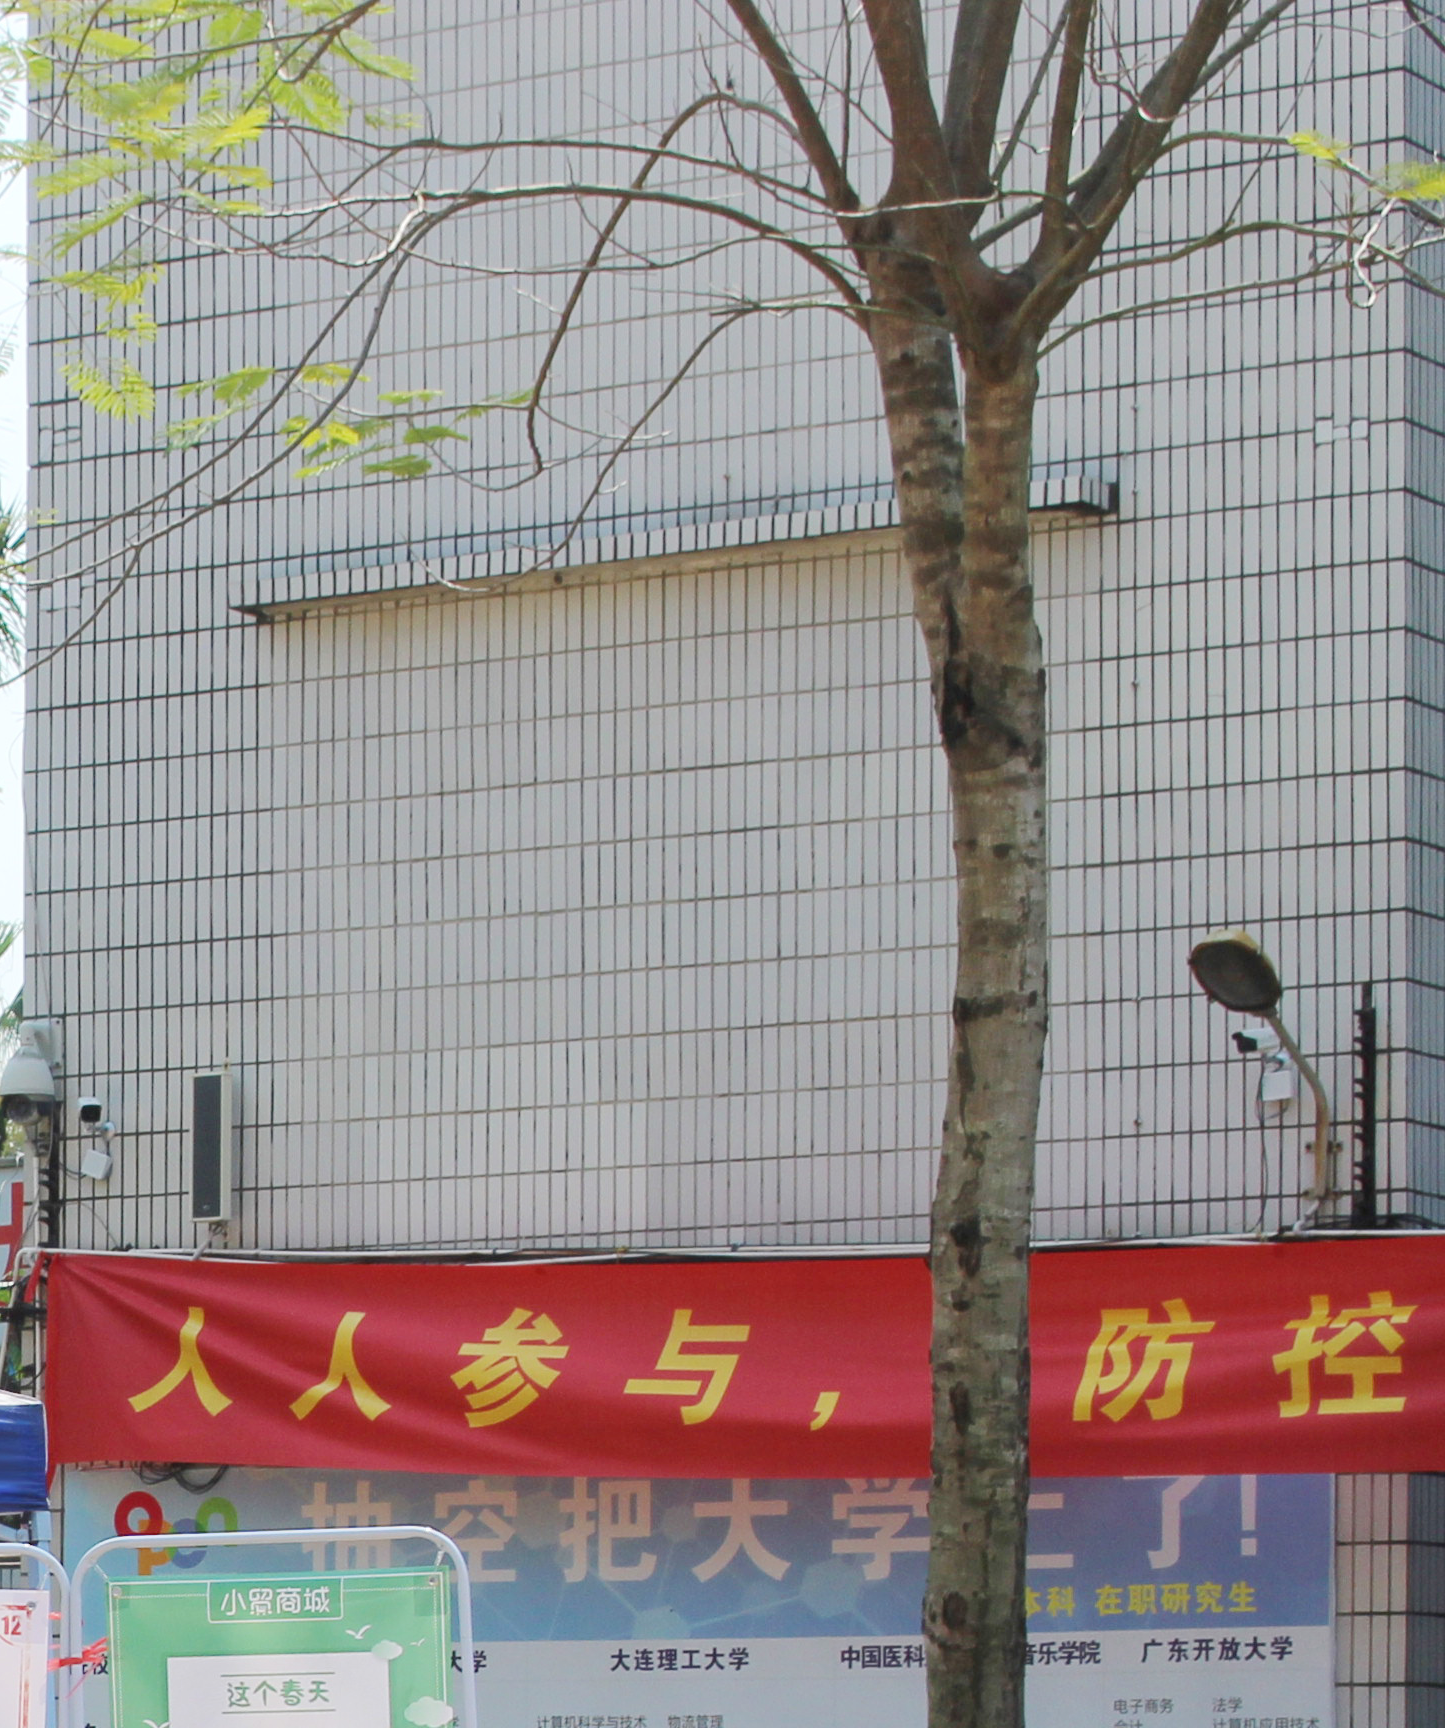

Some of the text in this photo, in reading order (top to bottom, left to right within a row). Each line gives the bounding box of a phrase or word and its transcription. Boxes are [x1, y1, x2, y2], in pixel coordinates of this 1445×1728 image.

[1095, 1580, 1258, 1616] 在职研究生
[1, 1615, 23, 1637] 12
[610, 1647, 750, 1672] 大连理工大学
[840, 1644, 927, 1670] 中国医科
[1140, 1635, 1294, 1663] 广东开放大学
[226, 1679, 331, 1708] 这个春天
[1113, 1698, 1175, 1714] 电子商务
[1211, 1698, 1244, 1713] 法学
